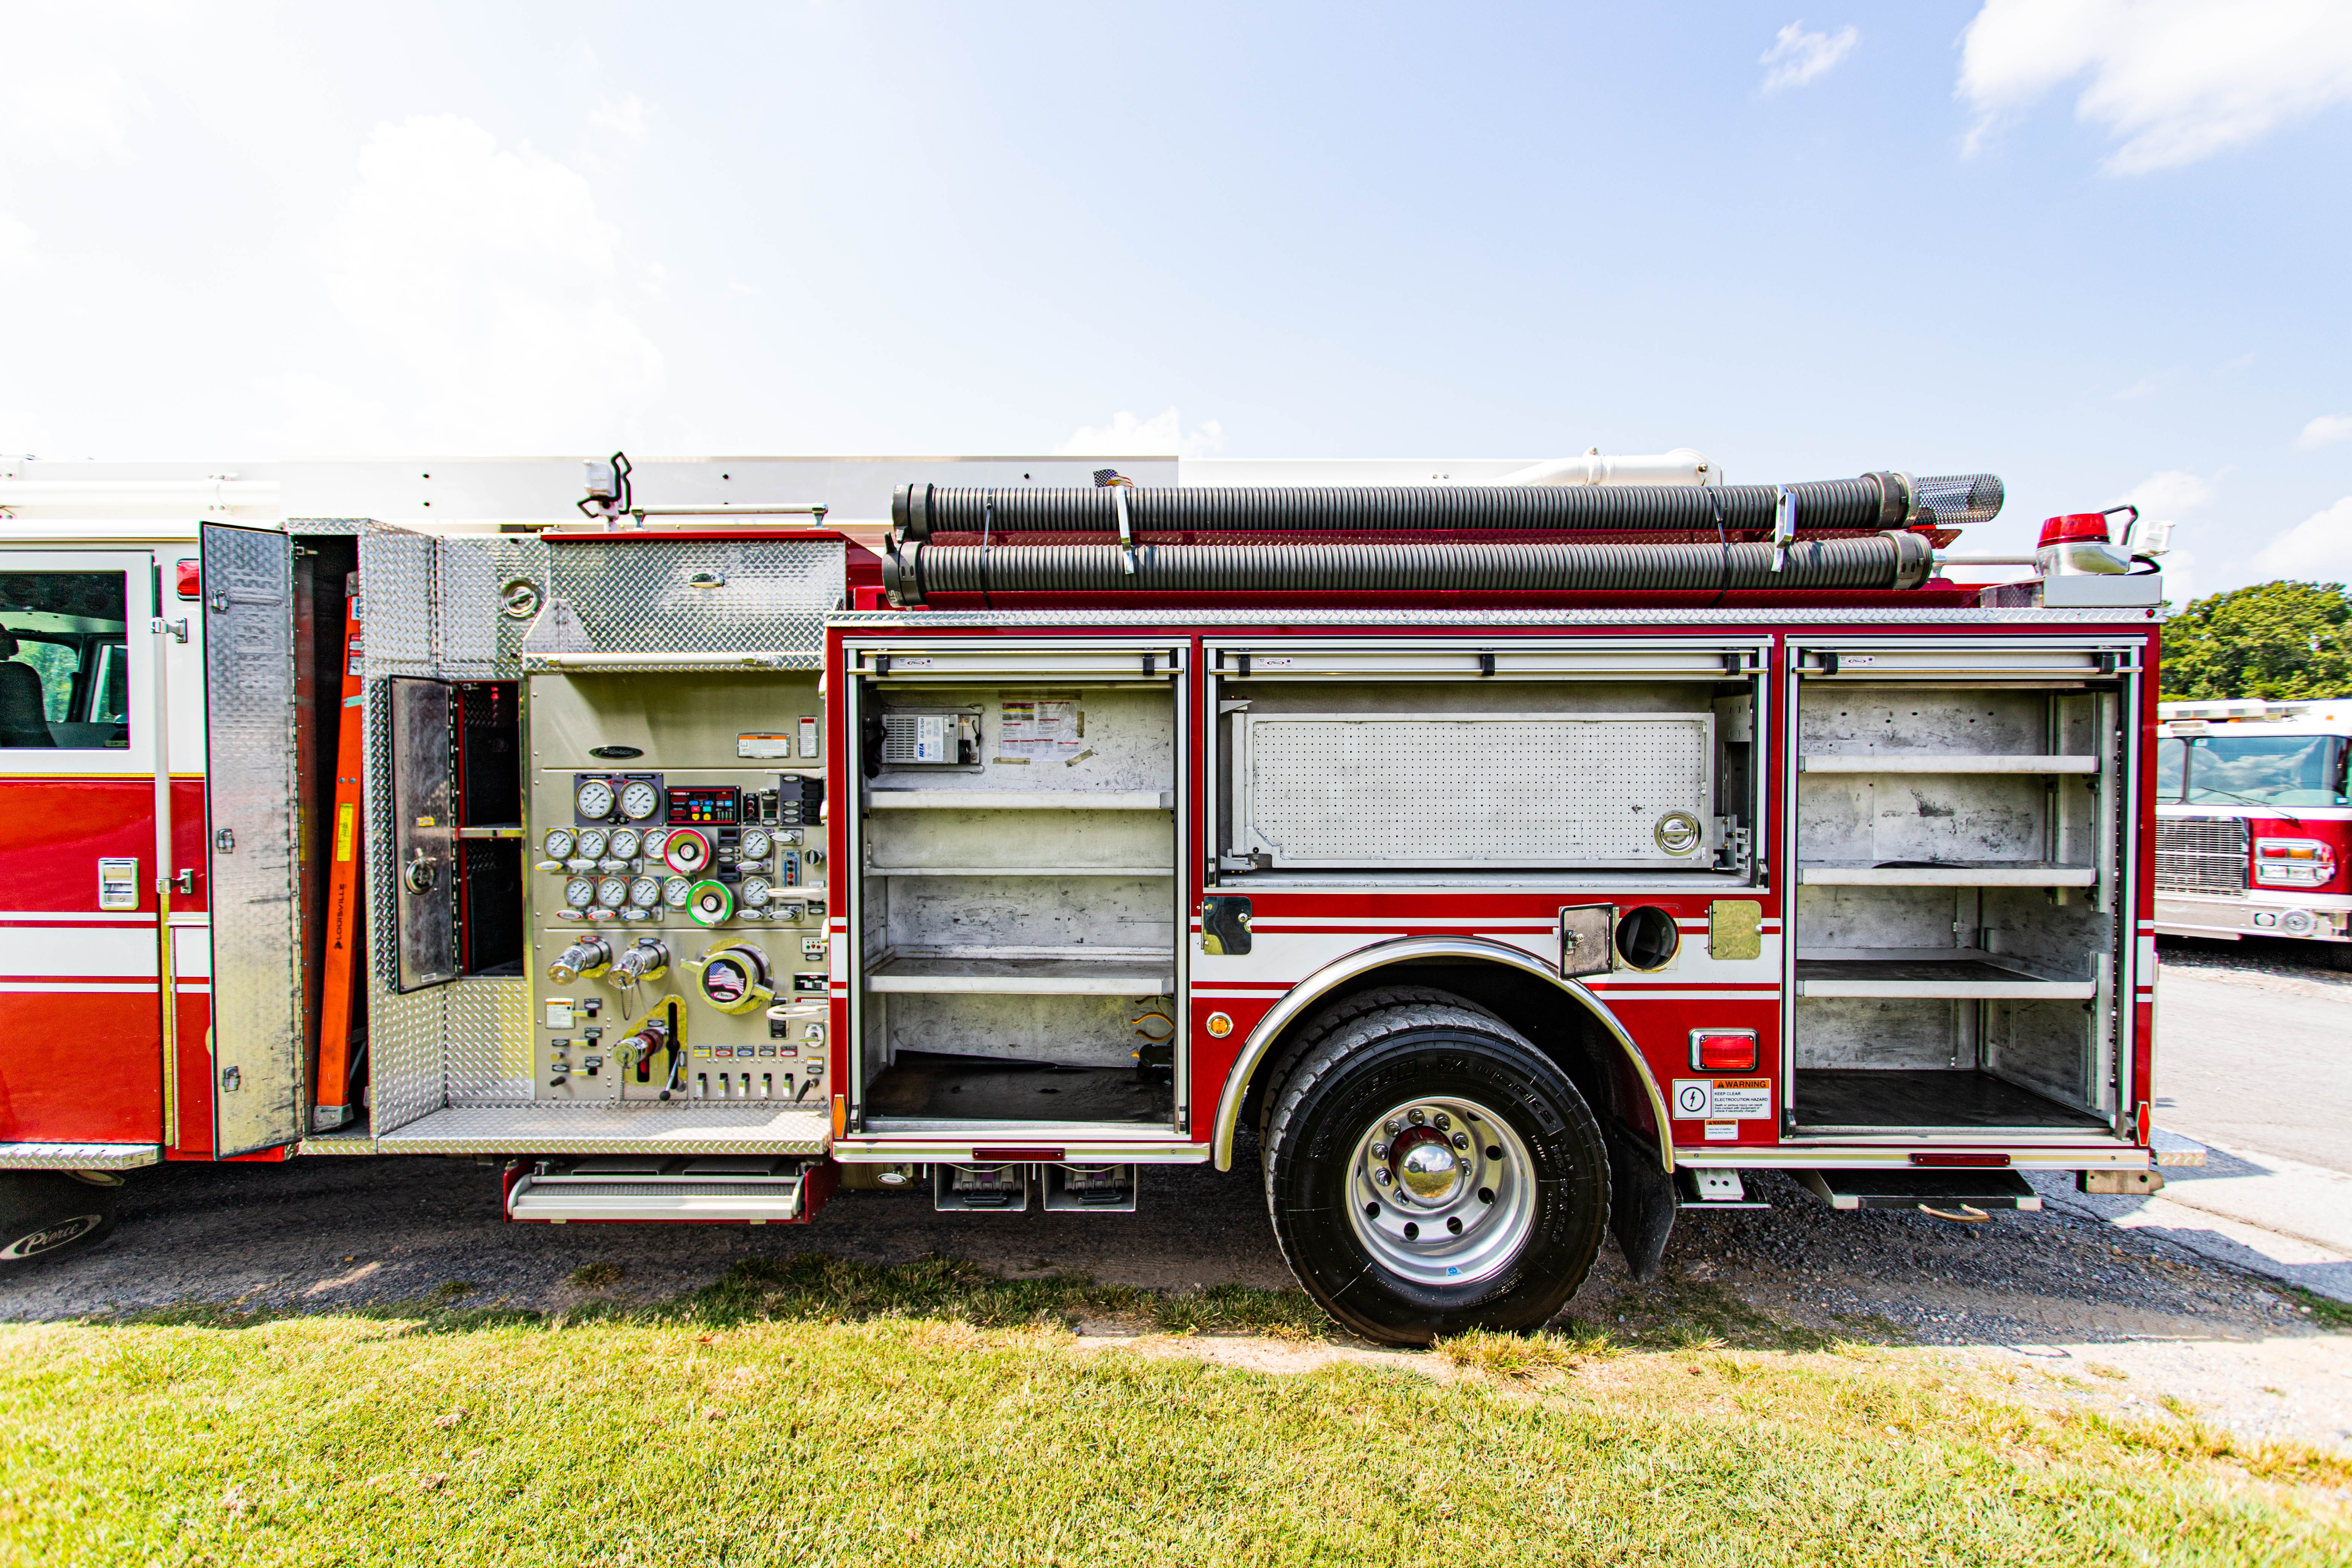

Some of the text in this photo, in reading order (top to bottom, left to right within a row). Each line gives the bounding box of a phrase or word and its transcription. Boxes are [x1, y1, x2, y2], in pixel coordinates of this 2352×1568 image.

[888, 590, 897, 602] US
[336, 884, 344, 940] LOUISVILLE
[24, 1223, 79, 1254] Pierce
